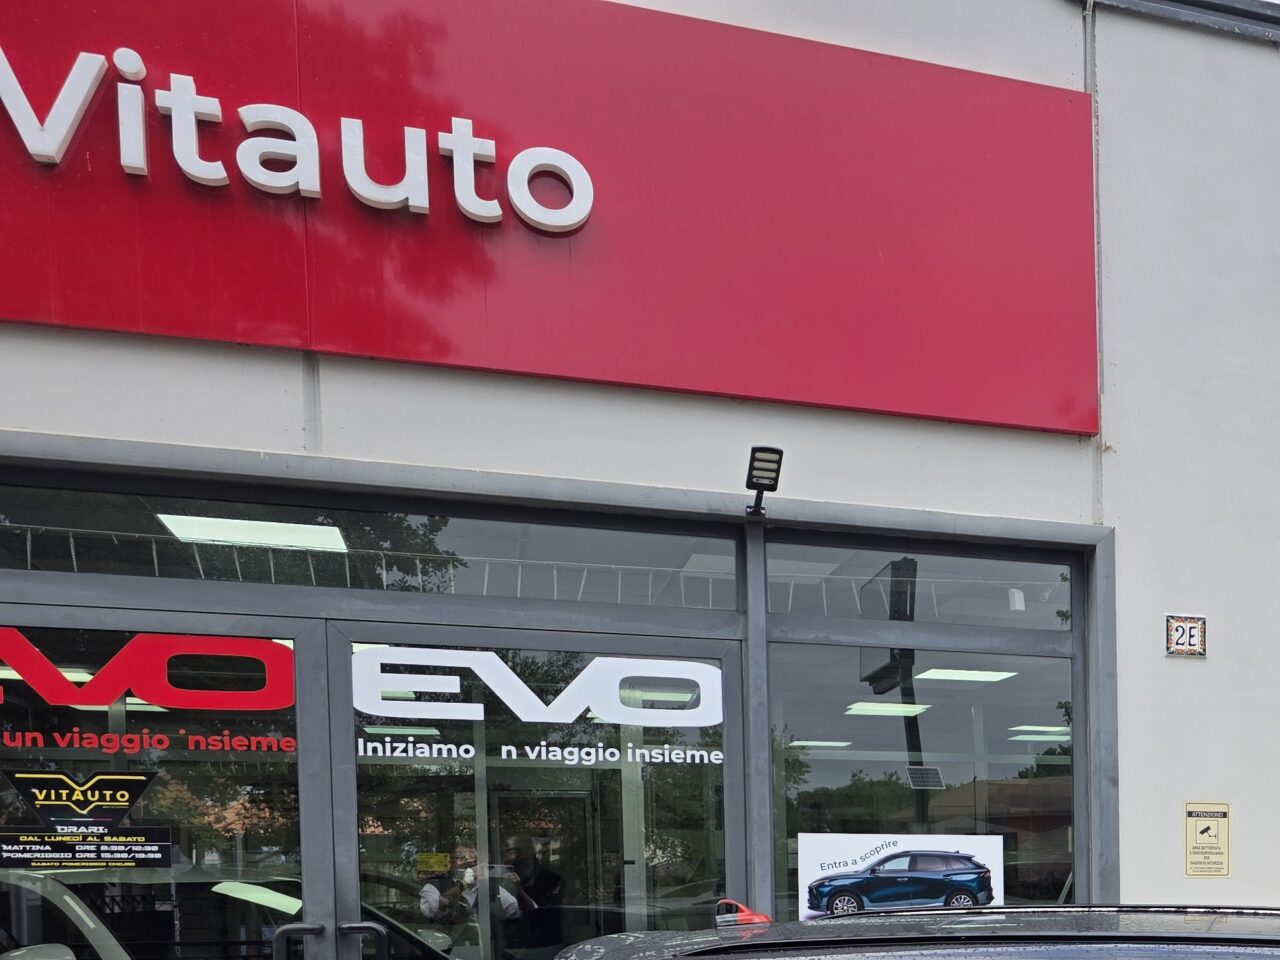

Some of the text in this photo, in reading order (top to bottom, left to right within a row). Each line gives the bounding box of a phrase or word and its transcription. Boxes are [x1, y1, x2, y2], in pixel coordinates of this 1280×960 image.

[0, 47, 594, 232] Vitauto
[1175, 625, 1198, 647] 2E
[0, 627, 296, 711] VO
[352, 646, 724, 727] EVO
[3, 726, 297, 754] un viaggio nsieme
[357, 736, 476, 758] Iniziamo
[524, 742, 620, 765] viaggio
[627, 743, 724, 764] insieme
[35, 789, 129, 801] VITAUTO
[820, 860, 849, 871] Entra
[859, 840, 899, 862] scoprire
